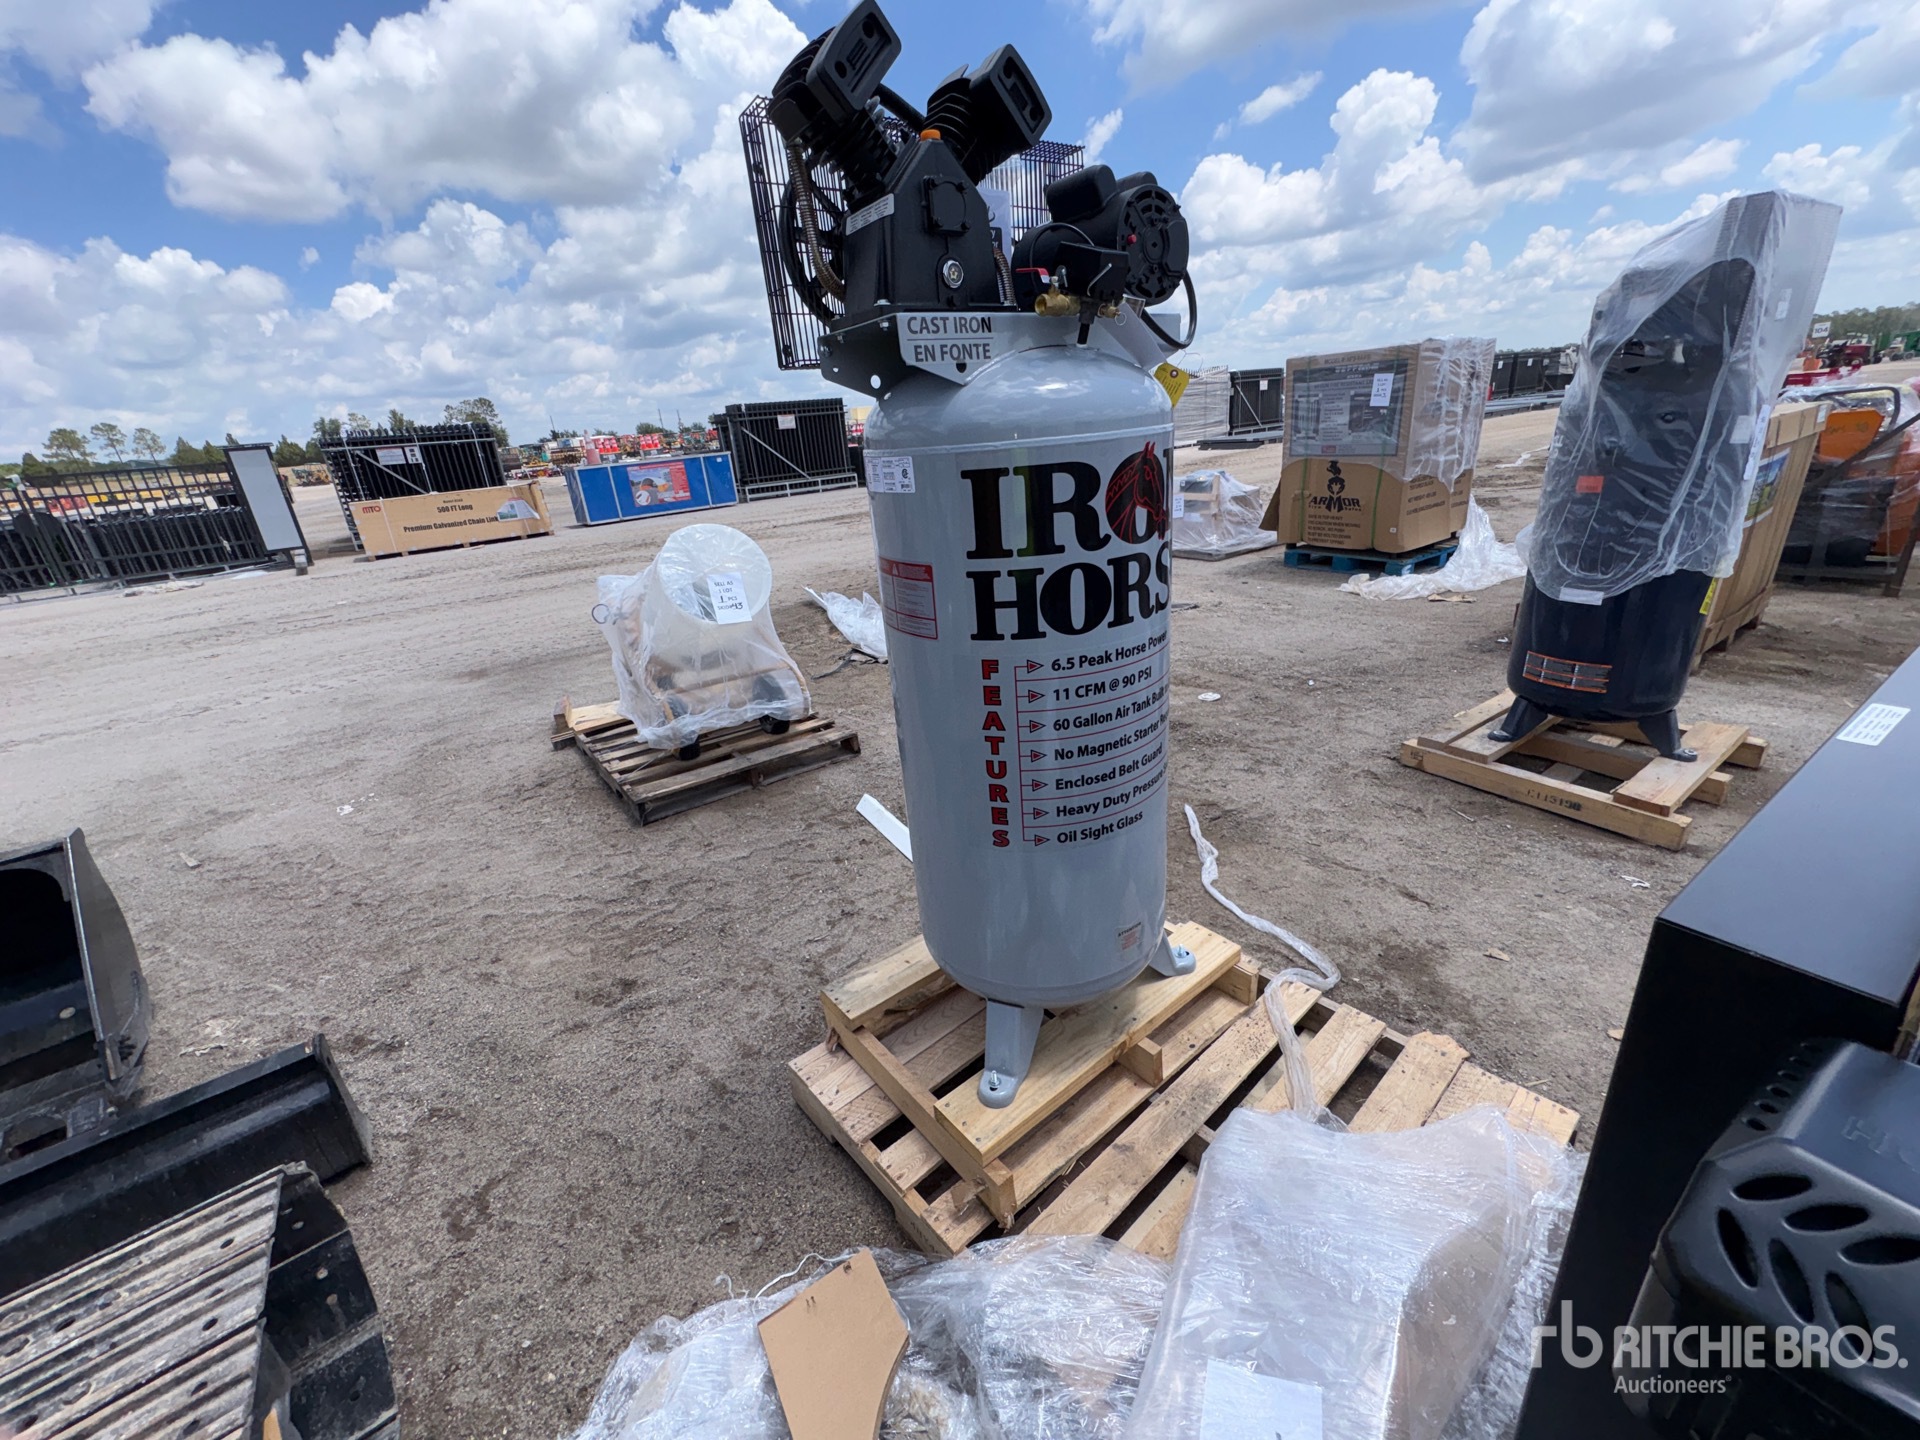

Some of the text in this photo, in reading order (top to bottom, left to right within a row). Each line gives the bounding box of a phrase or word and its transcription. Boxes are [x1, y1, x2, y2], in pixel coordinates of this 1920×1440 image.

[907, 316, 992, 334] CAST IRON
[913, 343, 991, 362] EN FONTE
[437, 505, 450, 513] 500
[1309, 494, 1361, 513] ARMOR
[403, 524, 433, 533] Premium
[433, 520, 468, 529] Galvanized
[468, 518, 486, 526] Chain
[1051, 630, 1168, 672] 6.5 Peak Horse Power
[1053, 666, 1152, 701] 11 CFM @ 90 PSI
[1053, 718, 1070, 731] 60
[1073, 712, 1113, 729] Gallon
[1115, 705, 1130, 721] Air
[1131, 696, 1151, 714] Tank
[982, 659, 1010, 848] FEATURES
[1054, 720, 1159, 761] No Magnetic Starter
[1055, 768, 1116, 791] Enclosed
[1118, 759, 1139, 777] Belt
[1141, 742, 1163, 766] Guard
[1056, 769, 1163, 818] Heavy Duty Pressure
[1057, 810, 1143, 844] Oil Sight Glass
